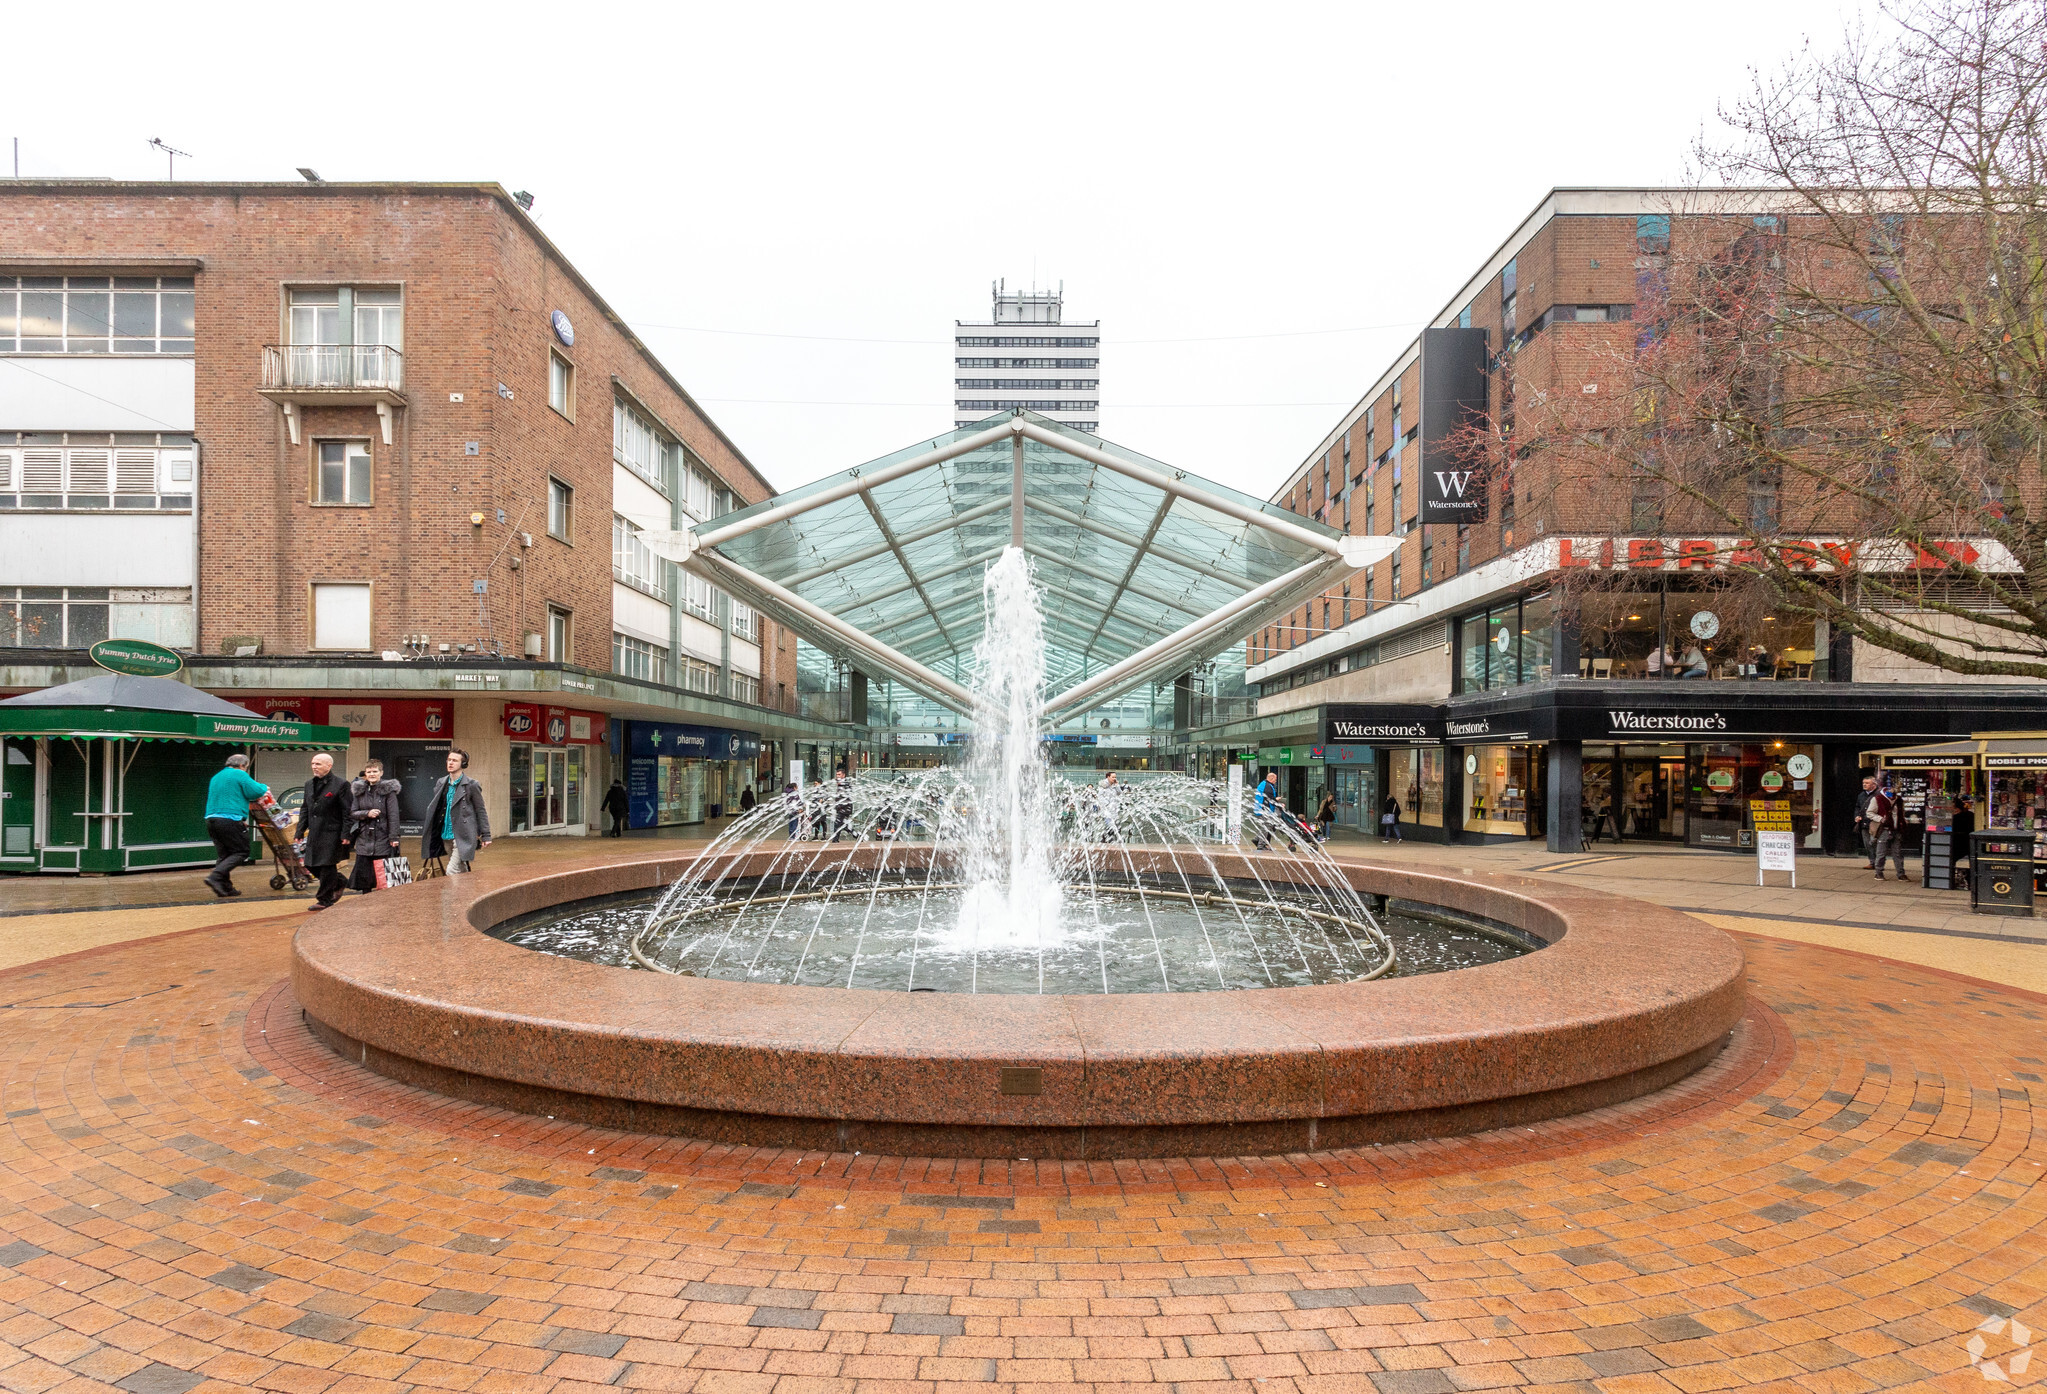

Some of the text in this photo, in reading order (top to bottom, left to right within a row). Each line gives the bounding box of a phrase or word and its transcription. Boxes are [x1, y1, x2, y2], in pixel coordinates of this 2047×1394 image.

[1433, 471, 1473, 498] W
[98, 647, 177, 664] Yummy Dutch Fries
[455, 674, 482, 682] MARKET
[265, 699, 301, 709] phones
[549, 707, 565, 716] phones
[342, 710, 367, 726] sky
[1609, 711, 1727, 730] Waterstone's
[213, 721, 299, 736] Yummy Dutch Fries
[1334, 722, 1426, 736] Waterstone's
[1446, 719, 1490, 735] Waterstone's
[677, 734, 705, 748] pharmacy
